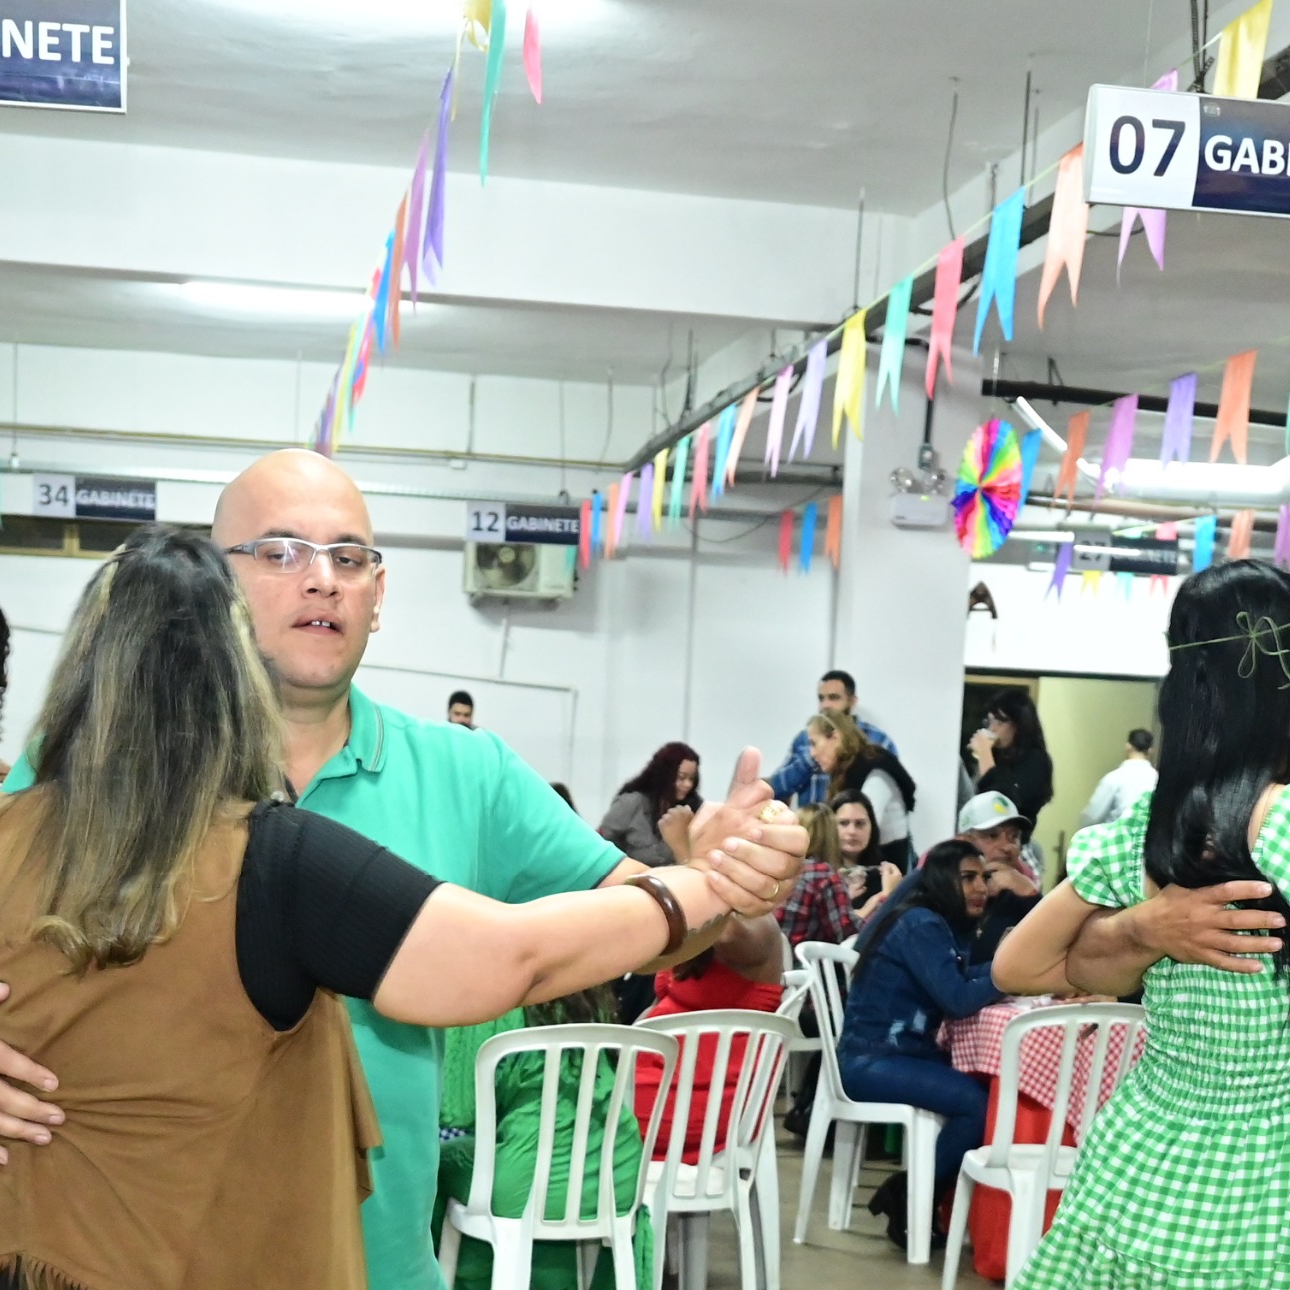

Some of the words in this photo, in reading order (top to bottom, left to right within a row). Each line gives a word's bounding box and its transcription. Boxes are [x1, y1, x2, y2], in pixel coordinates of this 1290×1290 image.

[1109, 115, 1186, 177] 07
[39, 484, 68, 506] 34
[76, 488, 155, 511] GABINETE
[472, 511, 499, 532] 12
[507, 515, 580, 534] GABINETE
